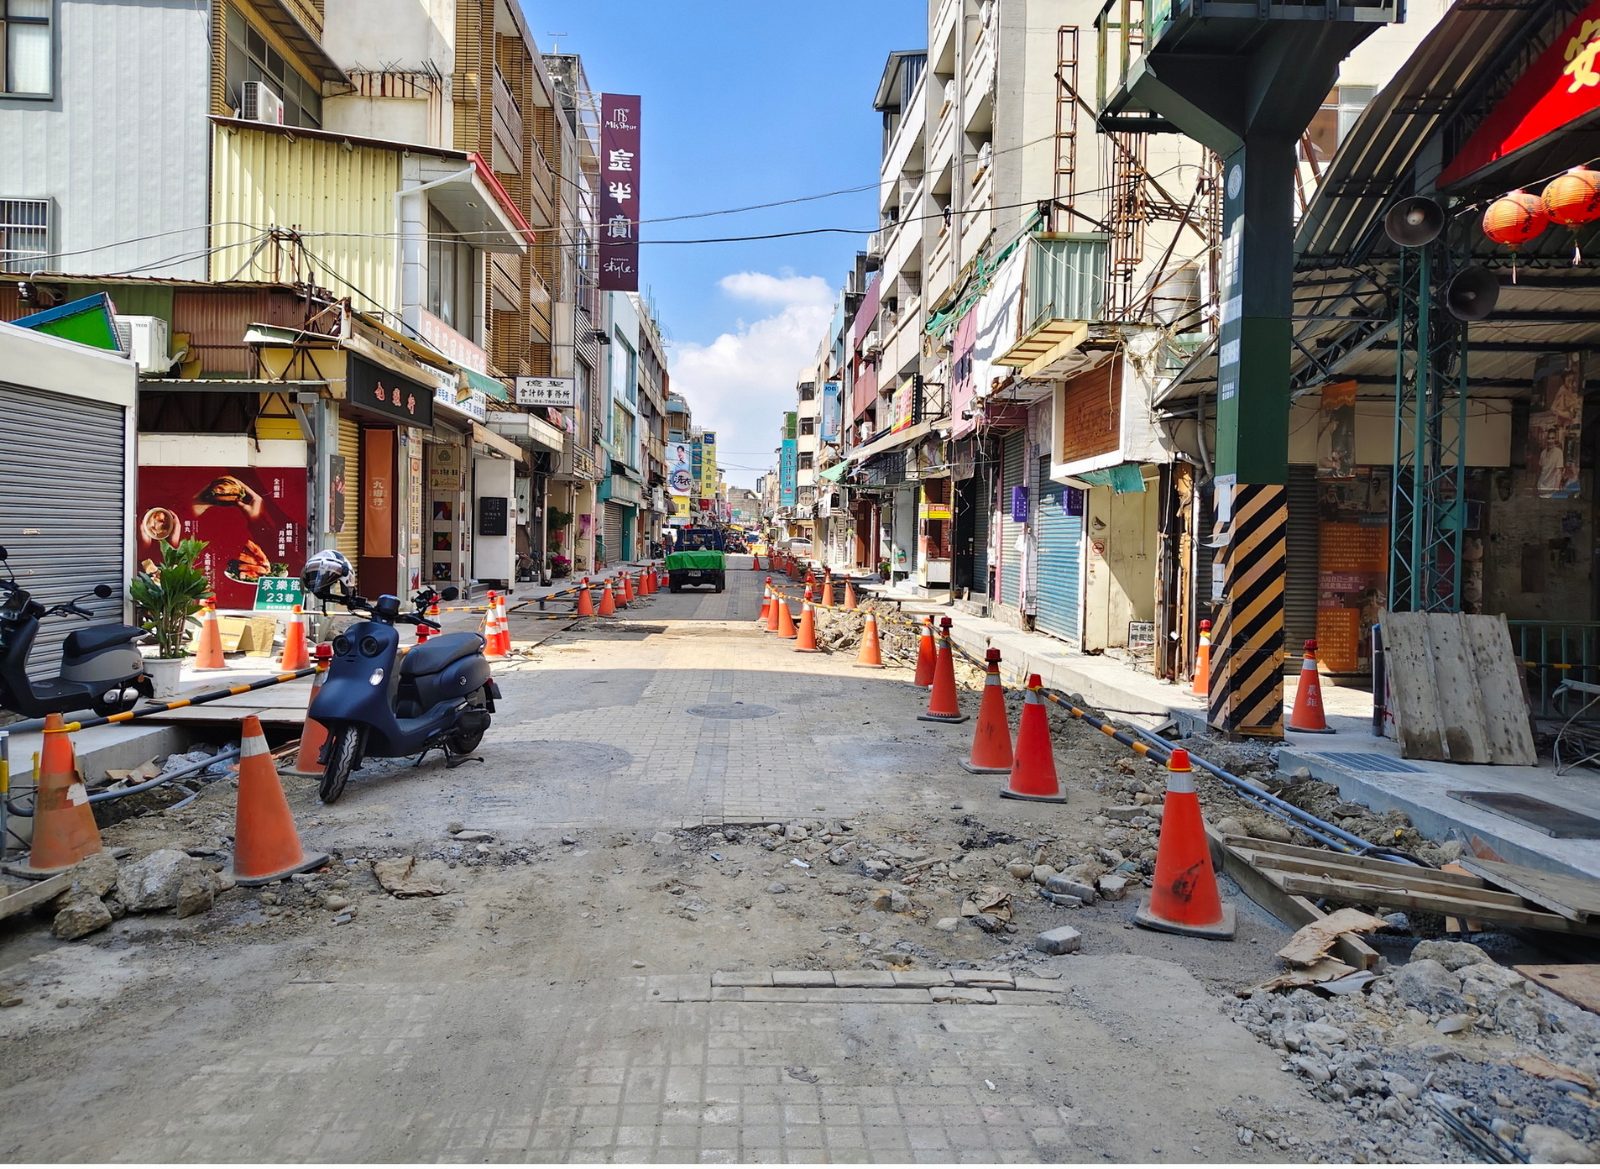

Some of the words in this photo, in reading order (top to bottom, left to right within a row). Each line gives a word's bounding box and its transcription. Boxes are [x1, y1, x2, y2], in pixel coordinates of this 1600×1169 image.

[520, 388, 570, 399] 會計師事務所
[266, 592, 295, 603] 23巷
